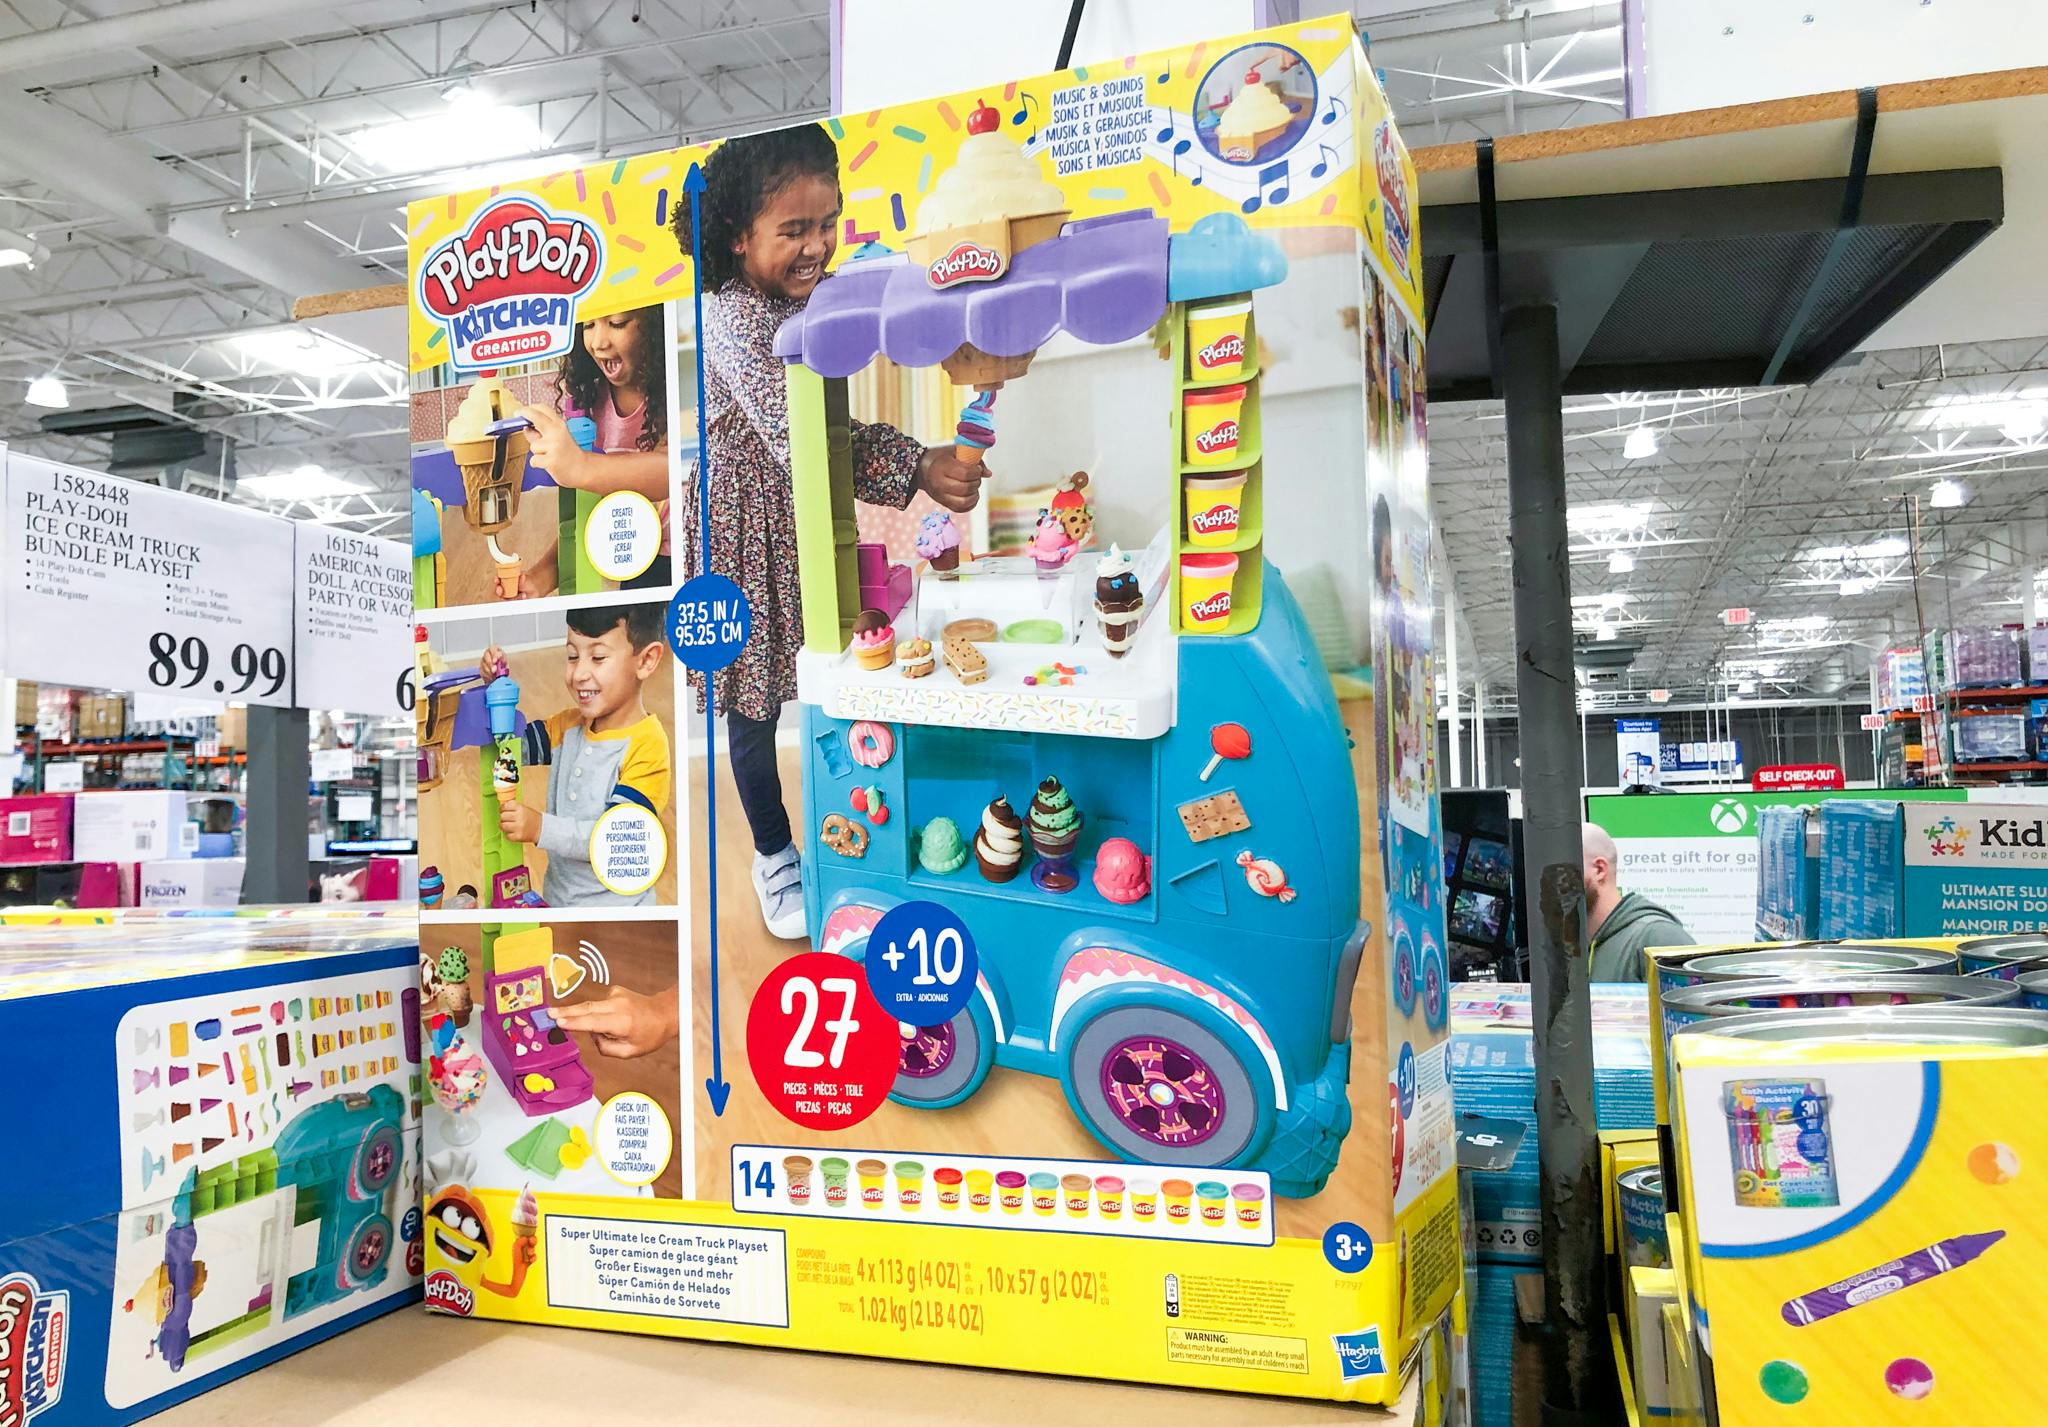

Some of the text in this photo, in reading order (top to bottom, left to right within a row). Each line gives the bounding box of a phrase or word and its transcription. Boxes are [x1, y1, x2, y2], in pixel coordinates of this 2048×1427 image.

[1090, 86, 1098, 99] &
[1104, 77, 1144, 98] SOUNDS
[1054, 94, 1143, 124] SONS ET MUSIQUE
[1046, 124, 1078, 142] MUSIK
[1082, 122, 1092, 135] &
[1052, 128, 1147, 158] MÚSICA Y SONIDOS
[1058, 147, 1142, 174] SONS E MÚSICAS
[426, 218, 590, 305] Play-Doh
[932, 250, 998, 282] Play-Doh
[53, 473, 130, 506] 1582448
[26, 492, 128, 528] PLAY-DOH
[612, 507, 632, 518] CREATE!
[26, 514, 201, 562] ICE CREAM TRUCK
[326, 534, 379, 559] 1615744
[26, 534, 193, 580] BUNDLE PLAYSET
[308, 552, 382, 578] AMERICAN
[614, 554, 632, 564] CRIAR!
[308, 570, 346, 590] DOLL
[308, 588, 377, 612] PARTY OR
[678, 602, 708, 624] 37.5
[714, 600, 727, 621] IN
[676, 622, 742, 647] 95.25 CM
[148, 632, 286, 697] 89.99
[1863, 716, 1883, 729] 306
[1760, 770, 1836, 782] SELF CHECK-OUT
[1980, 820, 2048, 848] Kid
[1624, 850, 1730, 866] great gift for
[1980, 852, 2048, 860] MADE FOR
[145, 886, 186, 898] FROZEN
[1942, 883, 2016, 898] ULTIMATE
[1942, 898, 2018, 912] MANSION
[1942, 919, 2033, 932] MANOIR DE
[882, 927, 964, 986] +10
[896, 993, 949, 1002] EXTRA ADICIONAIS
[780, 976, 860, 1069] 27
[784, 1081, 863, 1097] PIECES PIÈCES TEILE
[1765, 1086, 1804, 1096] Activity
[616, 1102, 634, 1112] CHECK
[796, 1102, 852, 1116] PIEZAS PEÇAS
[1800, 1100, 1818, 1118] 30
[738, 1160, 775, 1198] 14
[560, 1228, 768, 1254] Super Ultimate Ice Cream Truck Playset
[1336, 1234, 1366, 1261] 3+
[589, 1244, 738, 1266] Super camion de glace géant
[594, 1260, 733, 1280] Großer Eiswagen und mehr
[857, 1257, 865, 1282] 4
[868, 1263, 876, 1282] x
[879, 1258, 903, 1285] 113
[907, 1265, 916, 1292] g
[919, 1260, 932, 1290] (4
[936, 1261, 960, 1293] OZ)
[1007, 1273, 1016, 1294] x
[1019, 1268, 1036, 1296] 57
[1040, 1276, 1050, 1304] g
[1054, 1269, 1068, 1301] (2
[1071, 1270, 1097, 1304] OZ)
[424, 1276, 472, 1312] lay-Doh
[598, 1275, 730, 1296] Súper Camión de Helados
[1854, 1279, 1898, 1302] Crayola
[609, 1290, 720, 1310] Caminhão de Sorvete
[1168, 1304, 1178, 1314] x2
[860, 1296, 984, 1336] 1.02 kg (2 LB 4 OZ)
[1184, 1332, 1228, 1344] WARNING:
[1170, 1341, 1191, 1351] Product
[1192, 1344, 1206, 1352] must
[1206, 1344, 1213, 1352] be
[1214, 1345, 1242, 1355] assembled
[1244, 1348, 1250, 1357] by
[1275, 1350, 1290, 1361] Keep
[1290, 1352, 1304, 1360] small
[1171, 1352, 1185, 1360] parts
[1186, 1354, 1212, 1362] necessary
[1212, 1354, 1220, 1362] for
[1220, 1355, 1245, 1366] assembly
[1246, 1357, 1256, 1365] out
[1256, 1357, 1262, 1365] of
[1336, 1342, 1382, 1360] Hasbro
